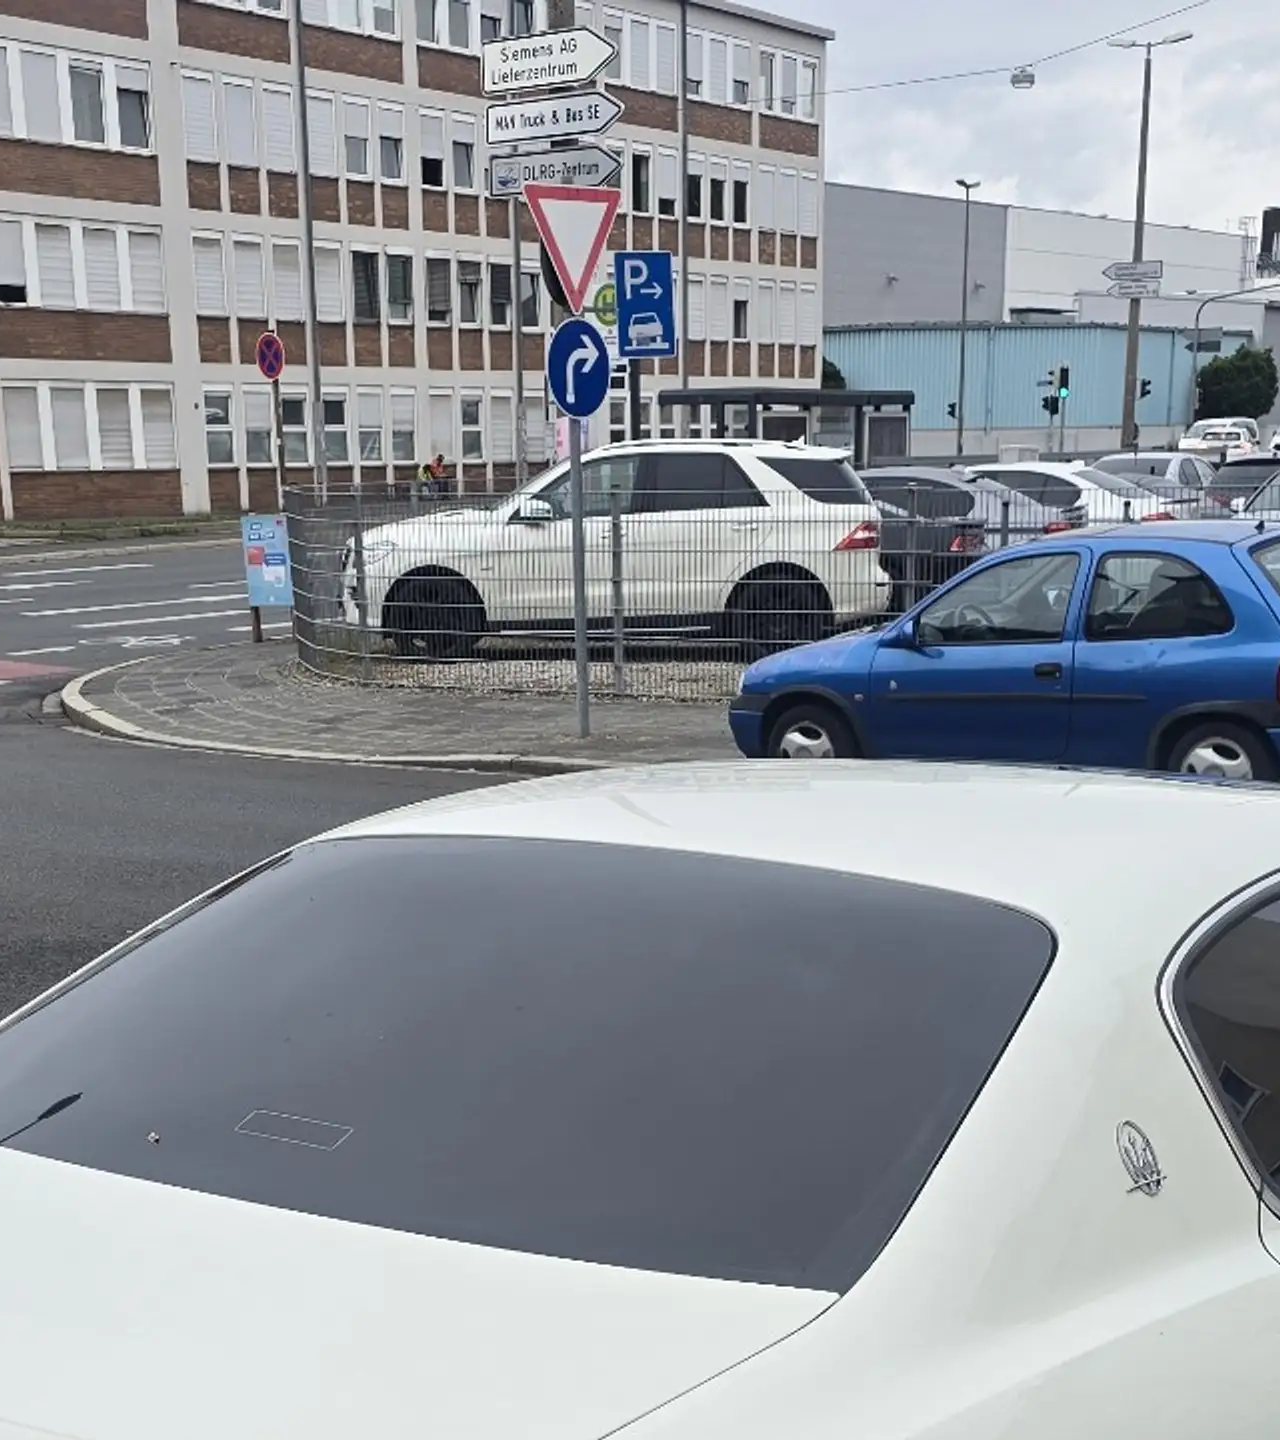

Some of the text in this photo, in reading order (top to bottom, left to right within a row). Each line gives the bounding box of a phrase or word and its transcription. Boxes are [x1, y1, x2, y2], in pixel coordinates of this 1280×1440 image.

[500, 38, 577, 63] Siemens AG
[492, 62, 578, 85] Lieferzentrum
[496, 104, 600, 131] MAN Truck & Bus SE
[523, 162, 600, 181] DLRG-Zentrum
[624, 259, 649, 300] P
